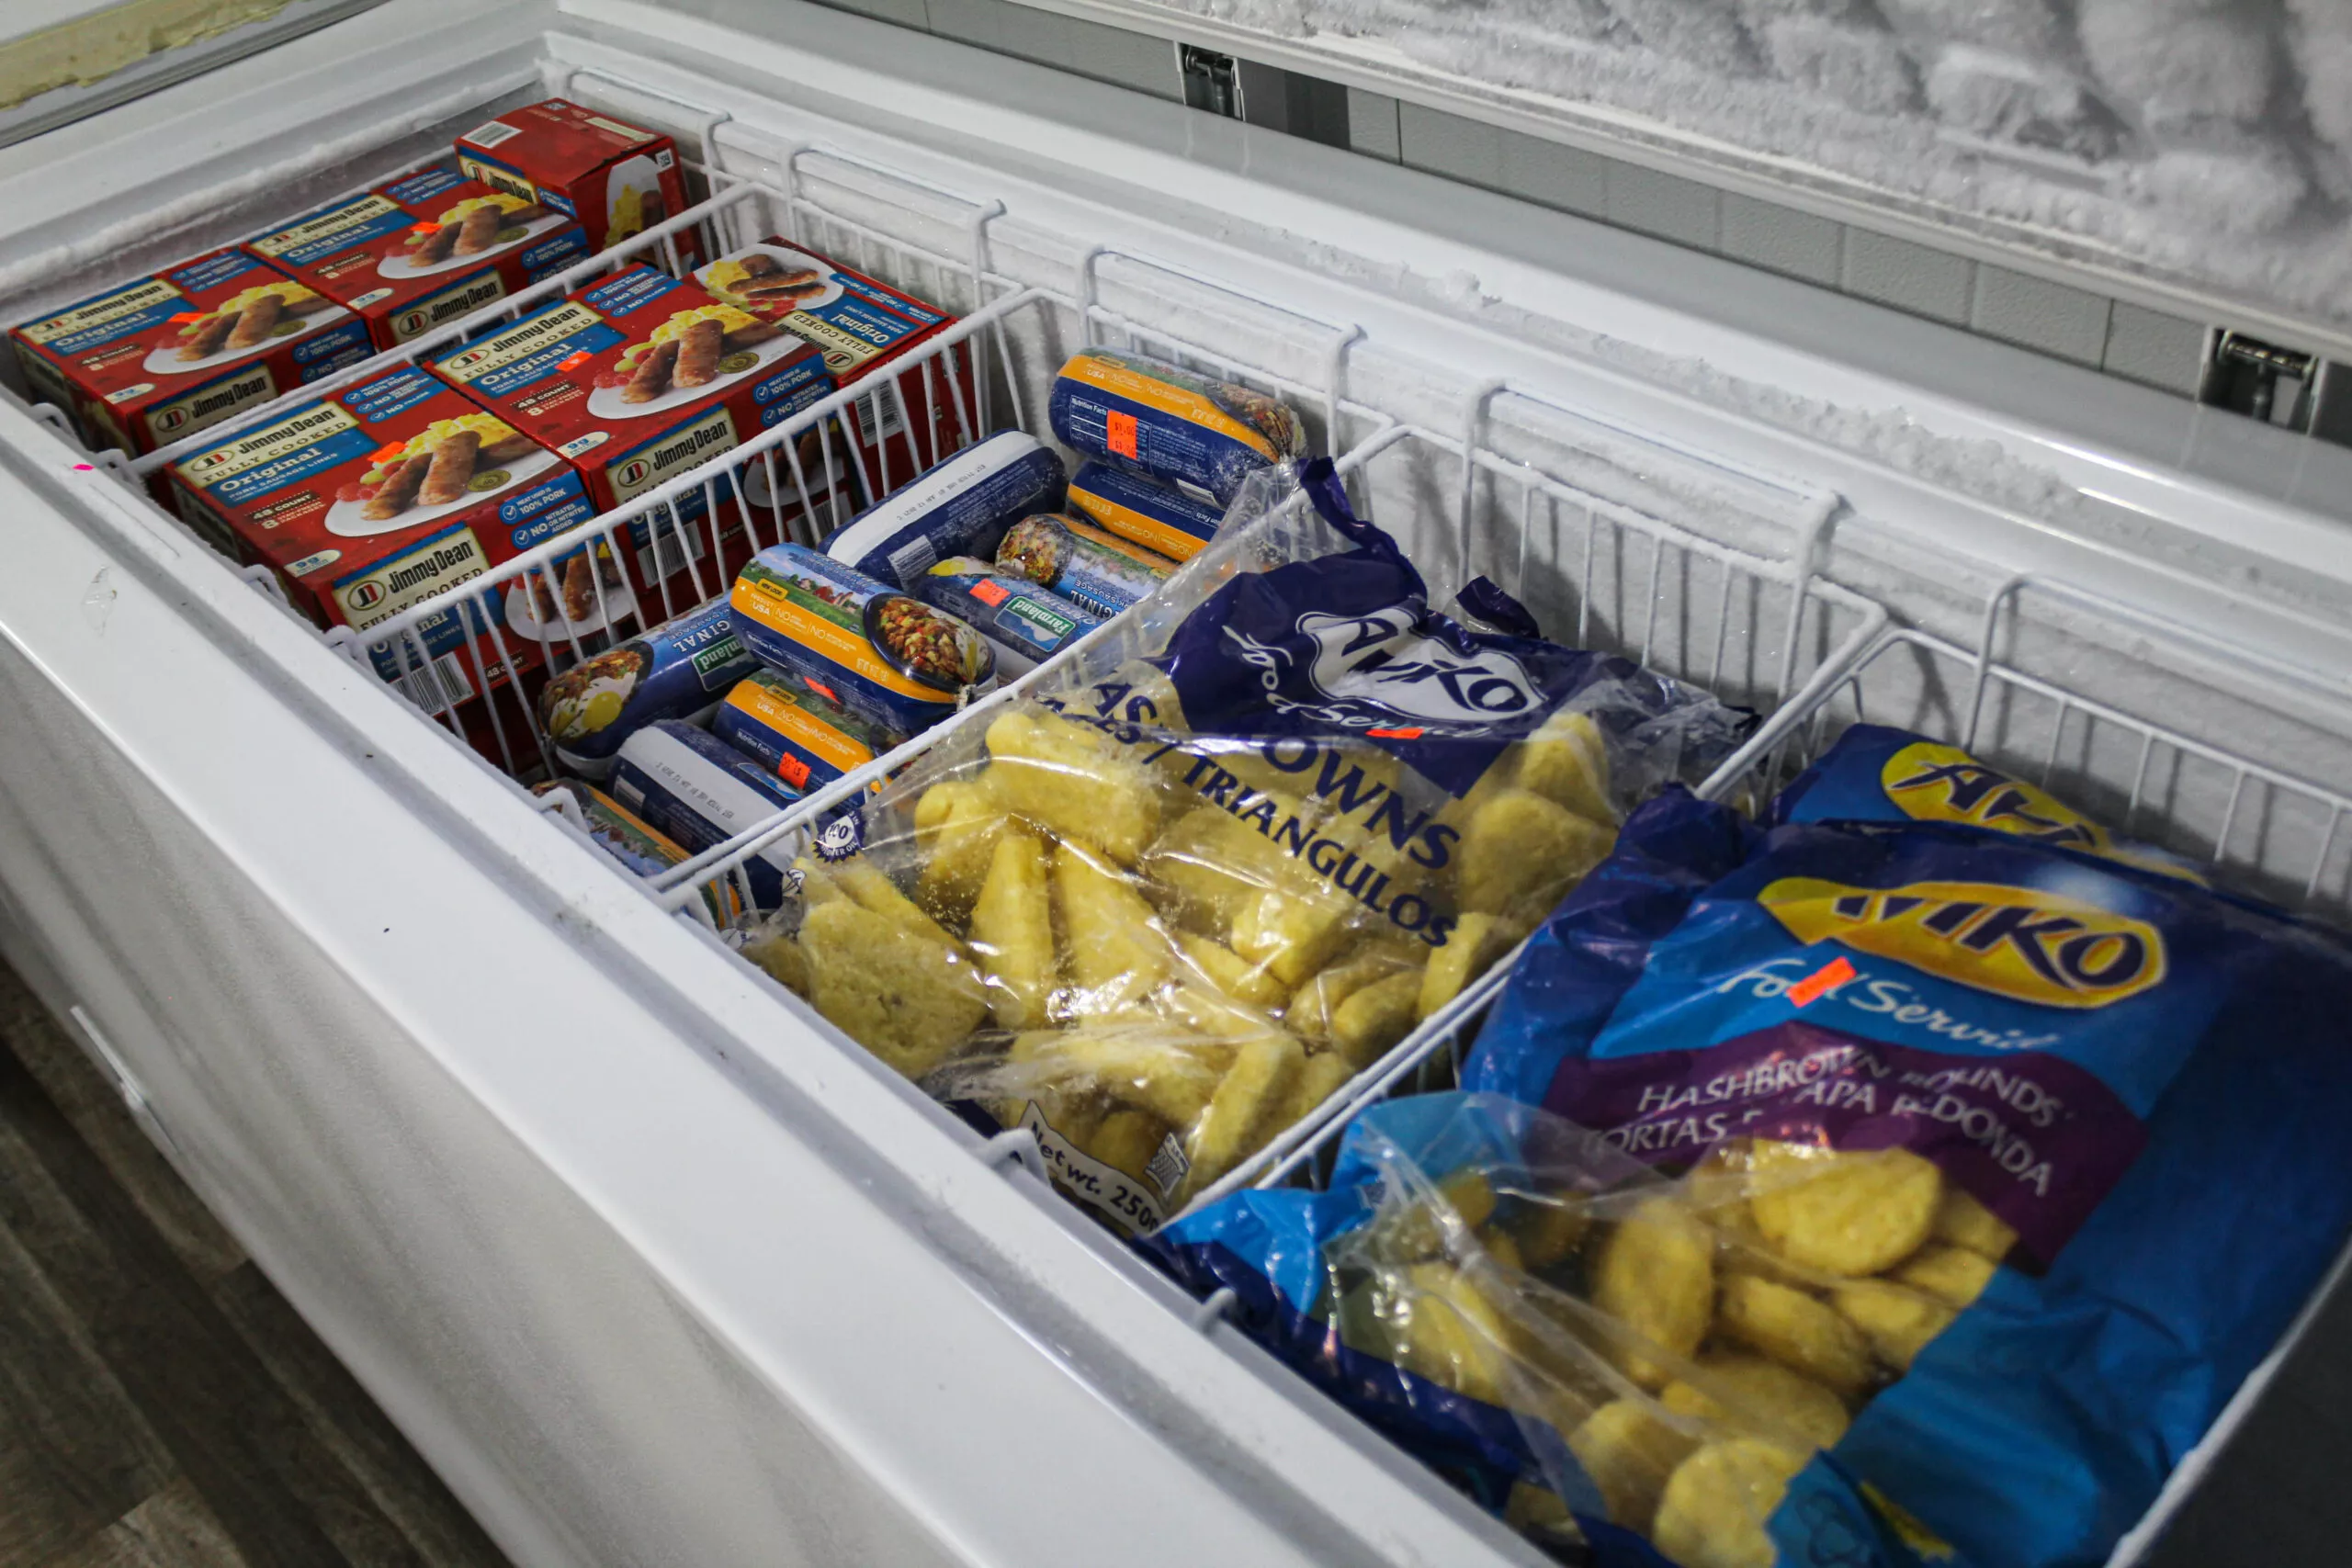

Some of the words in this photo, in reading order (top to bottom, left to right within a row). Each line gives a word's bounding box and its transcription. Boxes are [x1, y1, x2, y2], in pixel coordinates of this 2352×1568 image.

[288, 225, 371, 257] Original
[430, 294, 469, 321] Jimmy
[469, 282, 498, 305] Dean
[492, 324, 543, 354] Jimmy
[540, 307, 581, 332] Dean
[793, 313, 839, 338] COOKED
[831, 313, 890, 344] Original
[463, 353, 515, 378] FULLY
[521, 318, 593, 355] COOKED
[838, 337, 875, 355] FULLY
[481, 343, 572, 386] Original
[791, 369, 812, 385] PORK
[191, 383, 234, 418] Jimmy
[233, 377, 266, 403] Dean
[373, 395, 390, 405] NO
[386, 404, 403, 414] NO
[518, 398, 536, 409] 48
[537, 384, 571, 401] COUNT
[527, 407, 545, 416] 8
[777, 402, 792, 416] NO
[240, 424, 296, 455] Jimmy
[292, 408, 336, 437] Dean
[653, 436, 695, 470] Jimmy
[695, 421, 729, 446] Dean
[204, 456, 261, 482] FULLY
[268, 421, 347, 457] COOKED
[220, 447, 323, 492] Original
[253, 508, 273, 520] 48
[275, 493, 311, 512] COUNT
[519, 500, 543, 513] 100%
[541, 488, 566, 504] PORK
[545, 502, 575, 521] NITRATES
[558, 505, 586, 523] NITRITES
[261, 519, 279, 529] 8
[530, 523, 548, 537] NO
[552, 519, 573, 534] ADDED
[389, 557, 439, 593] Jimmy
[434, 541, 474, 570] Dean
[1070, 589, 1114, 619] GINAL
[1075, 580, 1116, 604] SAUSAGE
[752, 602, 770, 615] USA
[775, 608, 790, 621] NO
[810, 625, 826, 639] NO
[1012, 600, 1069, 633] Farmland
[673, 620, 730, 652] GINAL
[699, 640, 741, 670] mland
[757, 702, 775, 716] USA
[1182, 752, 1459, 948] TRIANGULOS
[1067, 1165, 1103, 1195] wt.
